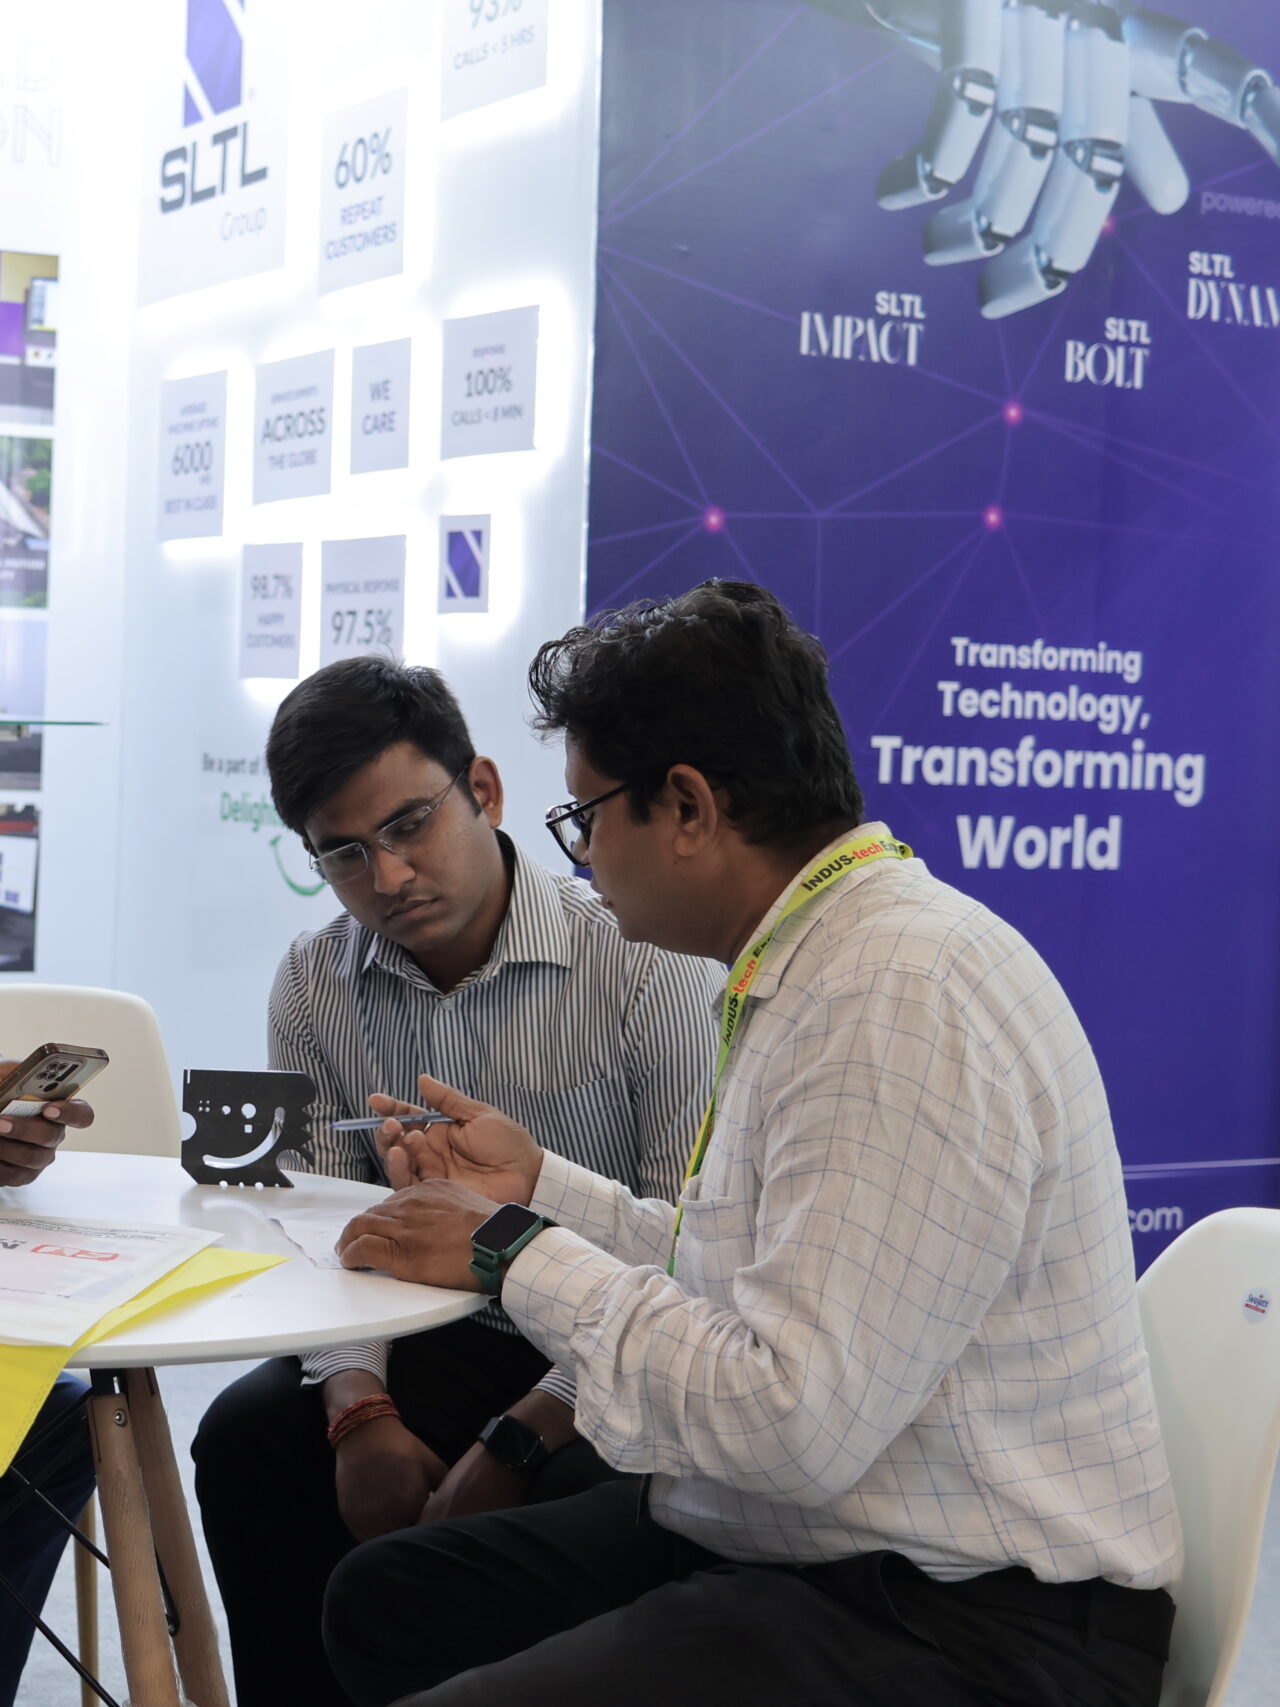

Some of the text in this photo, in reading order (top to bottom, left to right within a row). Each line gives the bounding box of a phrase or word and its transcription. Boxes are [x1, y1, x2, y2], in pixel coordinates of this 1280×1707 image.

[159, 121, 268, 214] SLTL
[334, 127, 393, 190] 60%
[221, 207, 268, 241] Group
[339, 195, 385, 227] REPEAT
[324, 221, 398, 261] CUSTOMERS
[1187, 250, 1235, 279] SLTL
[875, 290, 926, 320] SLTL
[800, 311, 924, 367] IMPACT
[1104, 316, 1153, 345] SLTL
[463, 365, 513, 399] 100%
[1064, 339, 1150, 390] BOLT
[369, 379, 393, 402] WE
[260, 406, 327, 446] ACROSS
[361, 409, 398, 436] CARE
[171, 440, 214, 476] 6000
[331, 607, 393, 646] 97.5%
[951, 636, 1142, 684] Transforming
[937, 681, 1151, 735] Technology,
[871, 735, 1206, 807] Transforming
[956, 814, 1123, 870] World
[1128, 1206, 1184, 1232] com
